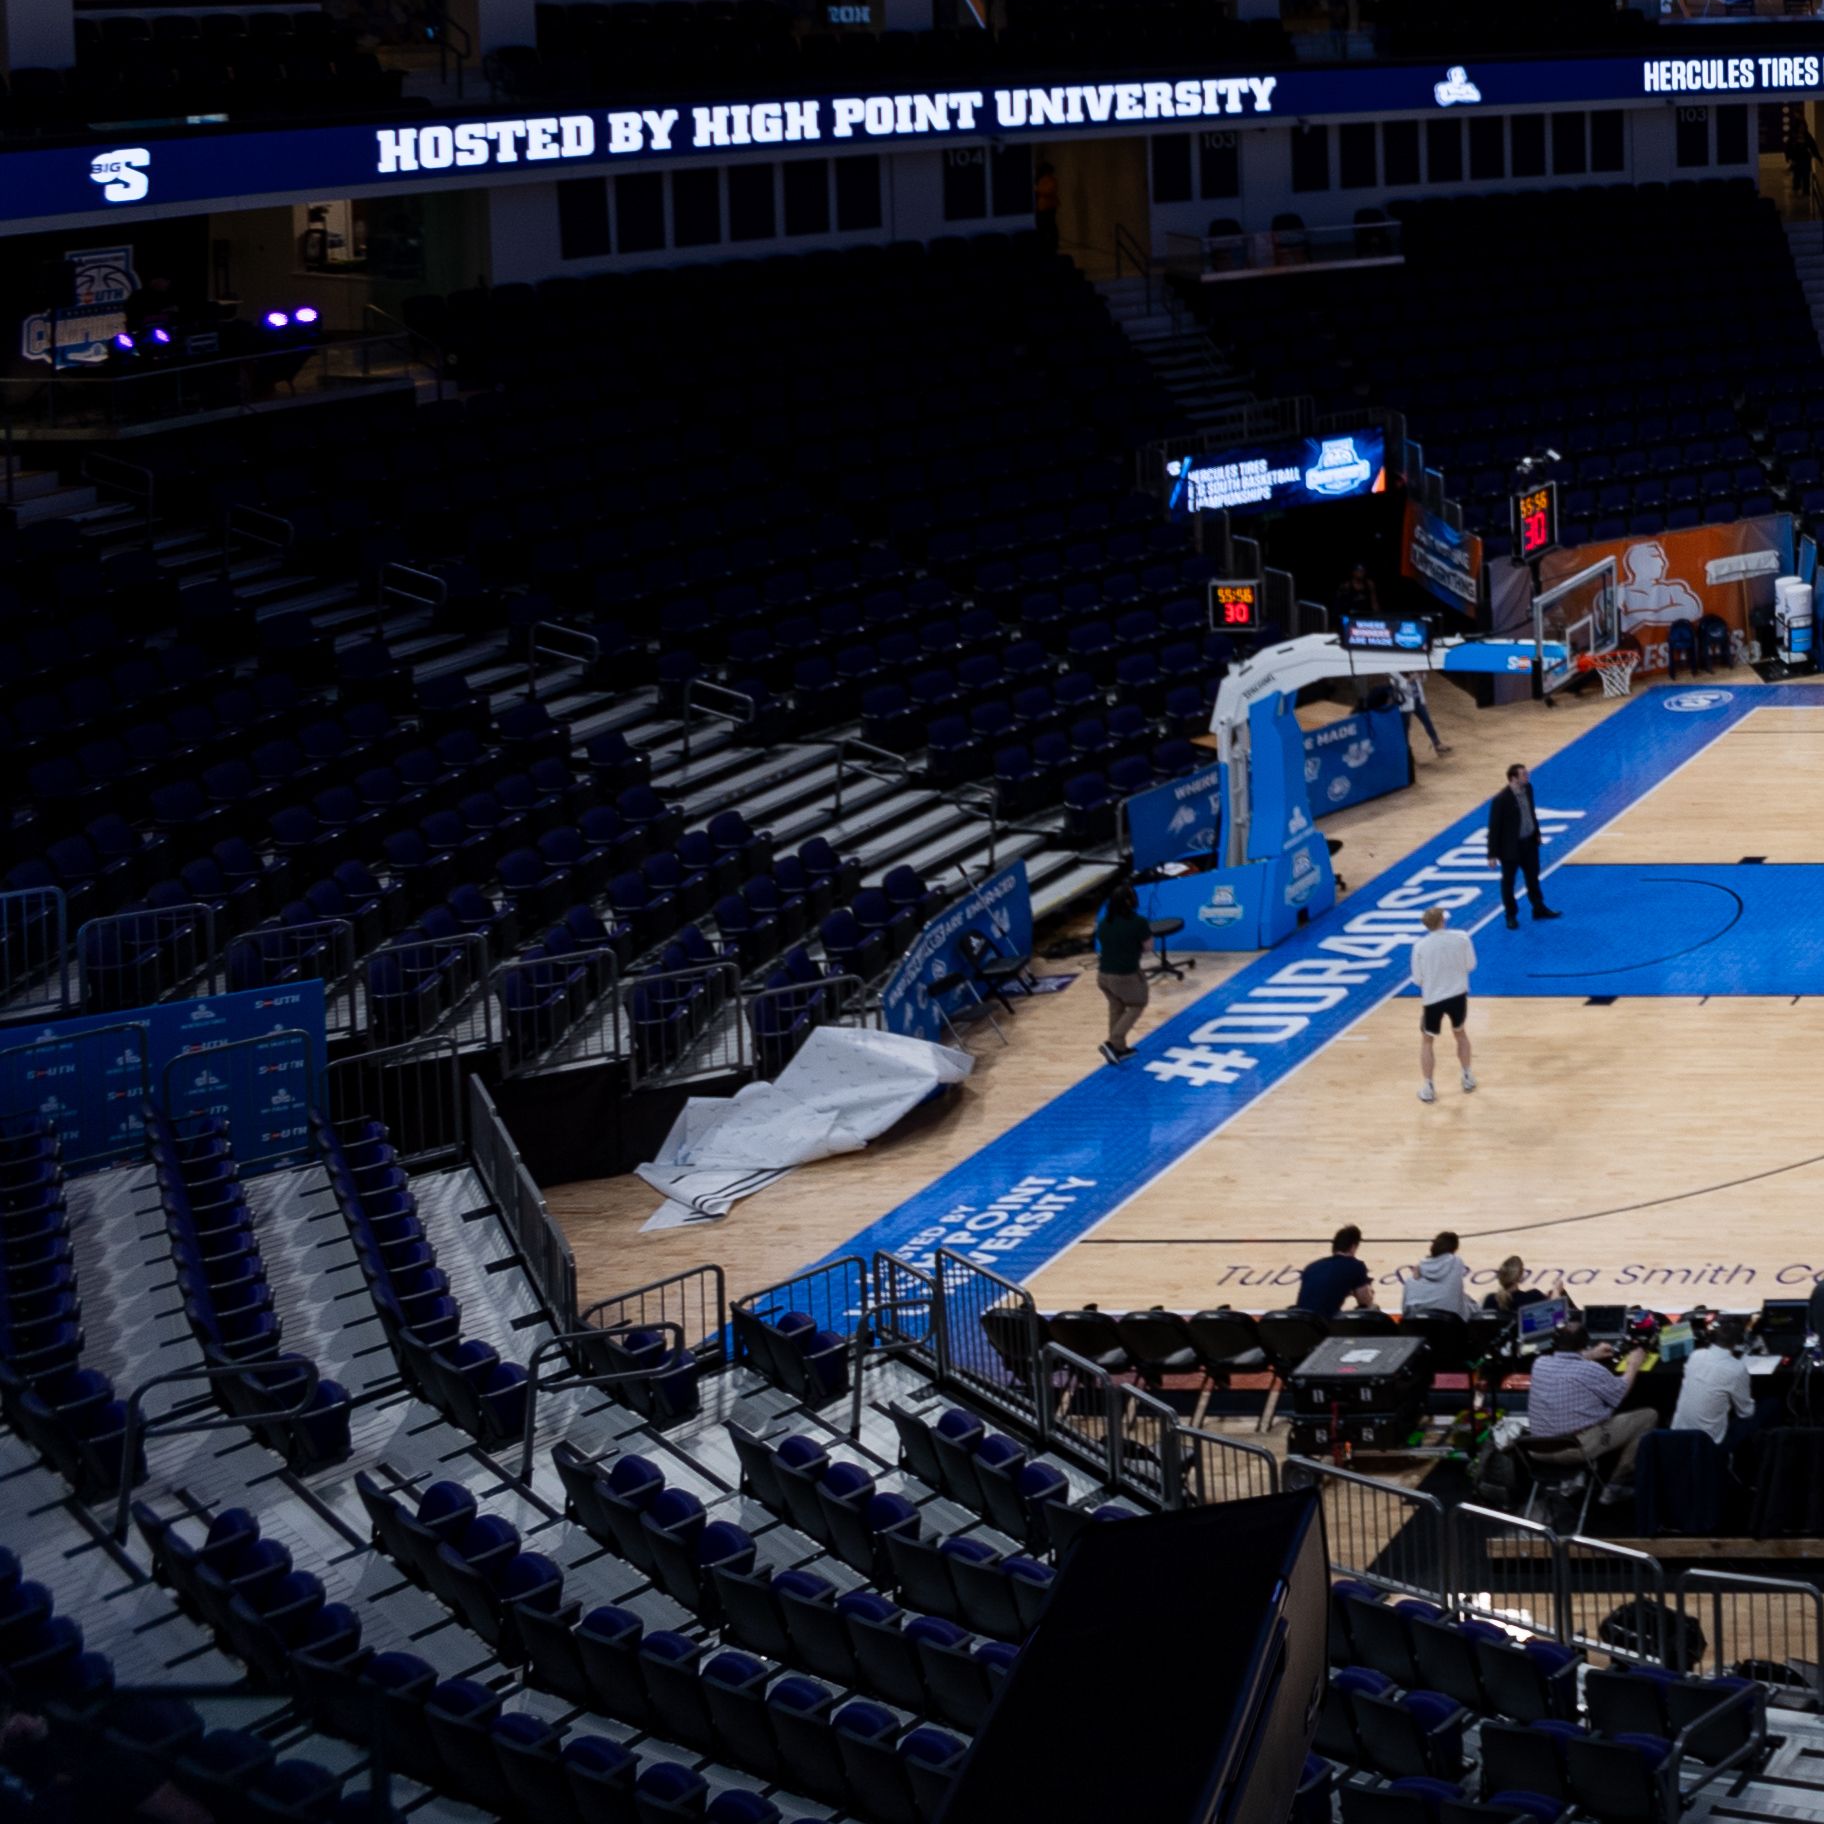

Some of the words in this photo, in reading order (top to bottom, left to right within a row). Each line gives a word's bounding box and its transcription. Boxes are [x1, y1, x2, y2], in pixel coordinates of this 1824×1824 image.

[1643, 57, 1756, 93] HERCULES
[1758, 55, 1819, 89] TIRES
[377, 114, 596, 174] HOSTED
[608, 110, 678, 156] BY
[692, 98, 821, 148] HIGH
[832, 89, 984, 139] POINT
[995, 76, 1278, 128] UNIVERSITY
[1678, 108, 1708, 123] 103
[1202, 133, 1237, 150] 103
[946, 148, 985, 168] 104
[1217, 586, 1255, 605] 55:56
[1223, 602, 1251, 625] 30
[942, 1176, 1058, 1246] POINT
[1610, 1261, 1760, 1286] Smith
